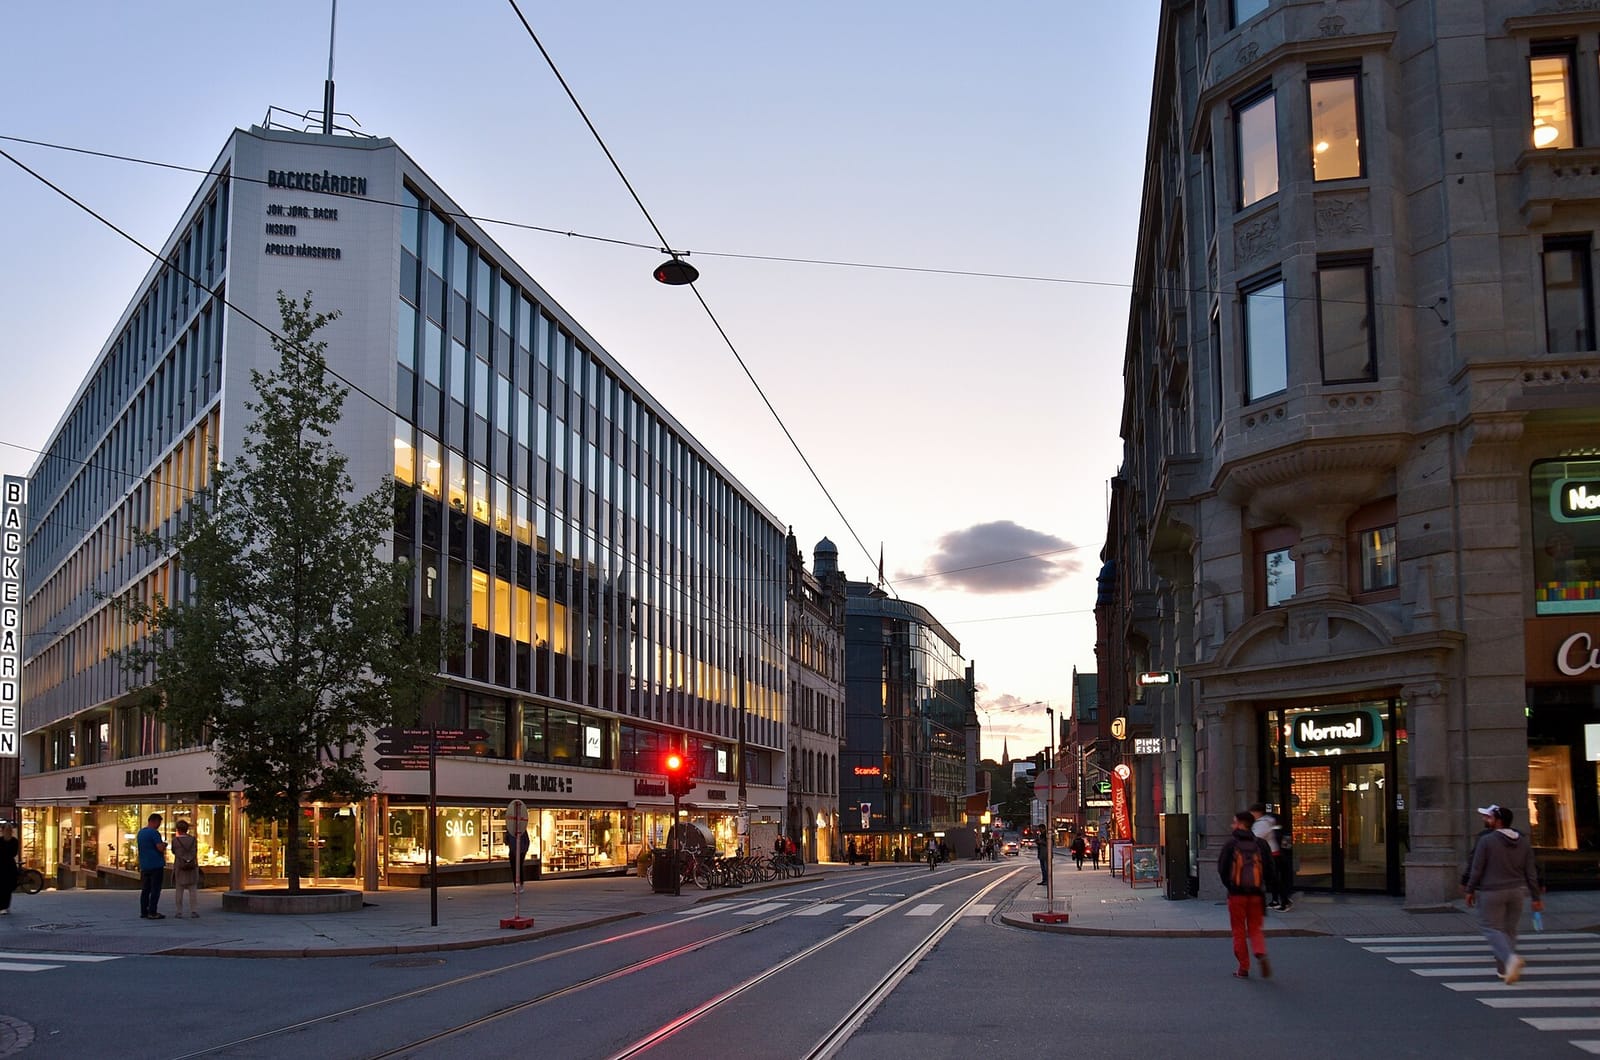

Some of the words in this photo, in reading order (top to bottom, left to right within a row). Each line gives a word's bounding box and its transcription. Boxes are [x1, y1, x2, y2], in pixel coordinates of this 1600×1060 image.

[268, 170, 367, 196] BACKEGÅRDEN
[313, 207, 338, 221] BACKE
[265, 223, 297, 236] INSENTI
[265, 242, 294, 256] APOLLO
[296, 243, 341, 260] HÅRSENTER
[1569, 485, 1600, 511] No
[1300, 718, 1362, 743] Normal
[1136, 738, 1160, 746] PINK
[1136, 746, 1160, 754] FISH
[854, 767, 881, 775] Scandic
[445, 820, 474, 836] SALG
